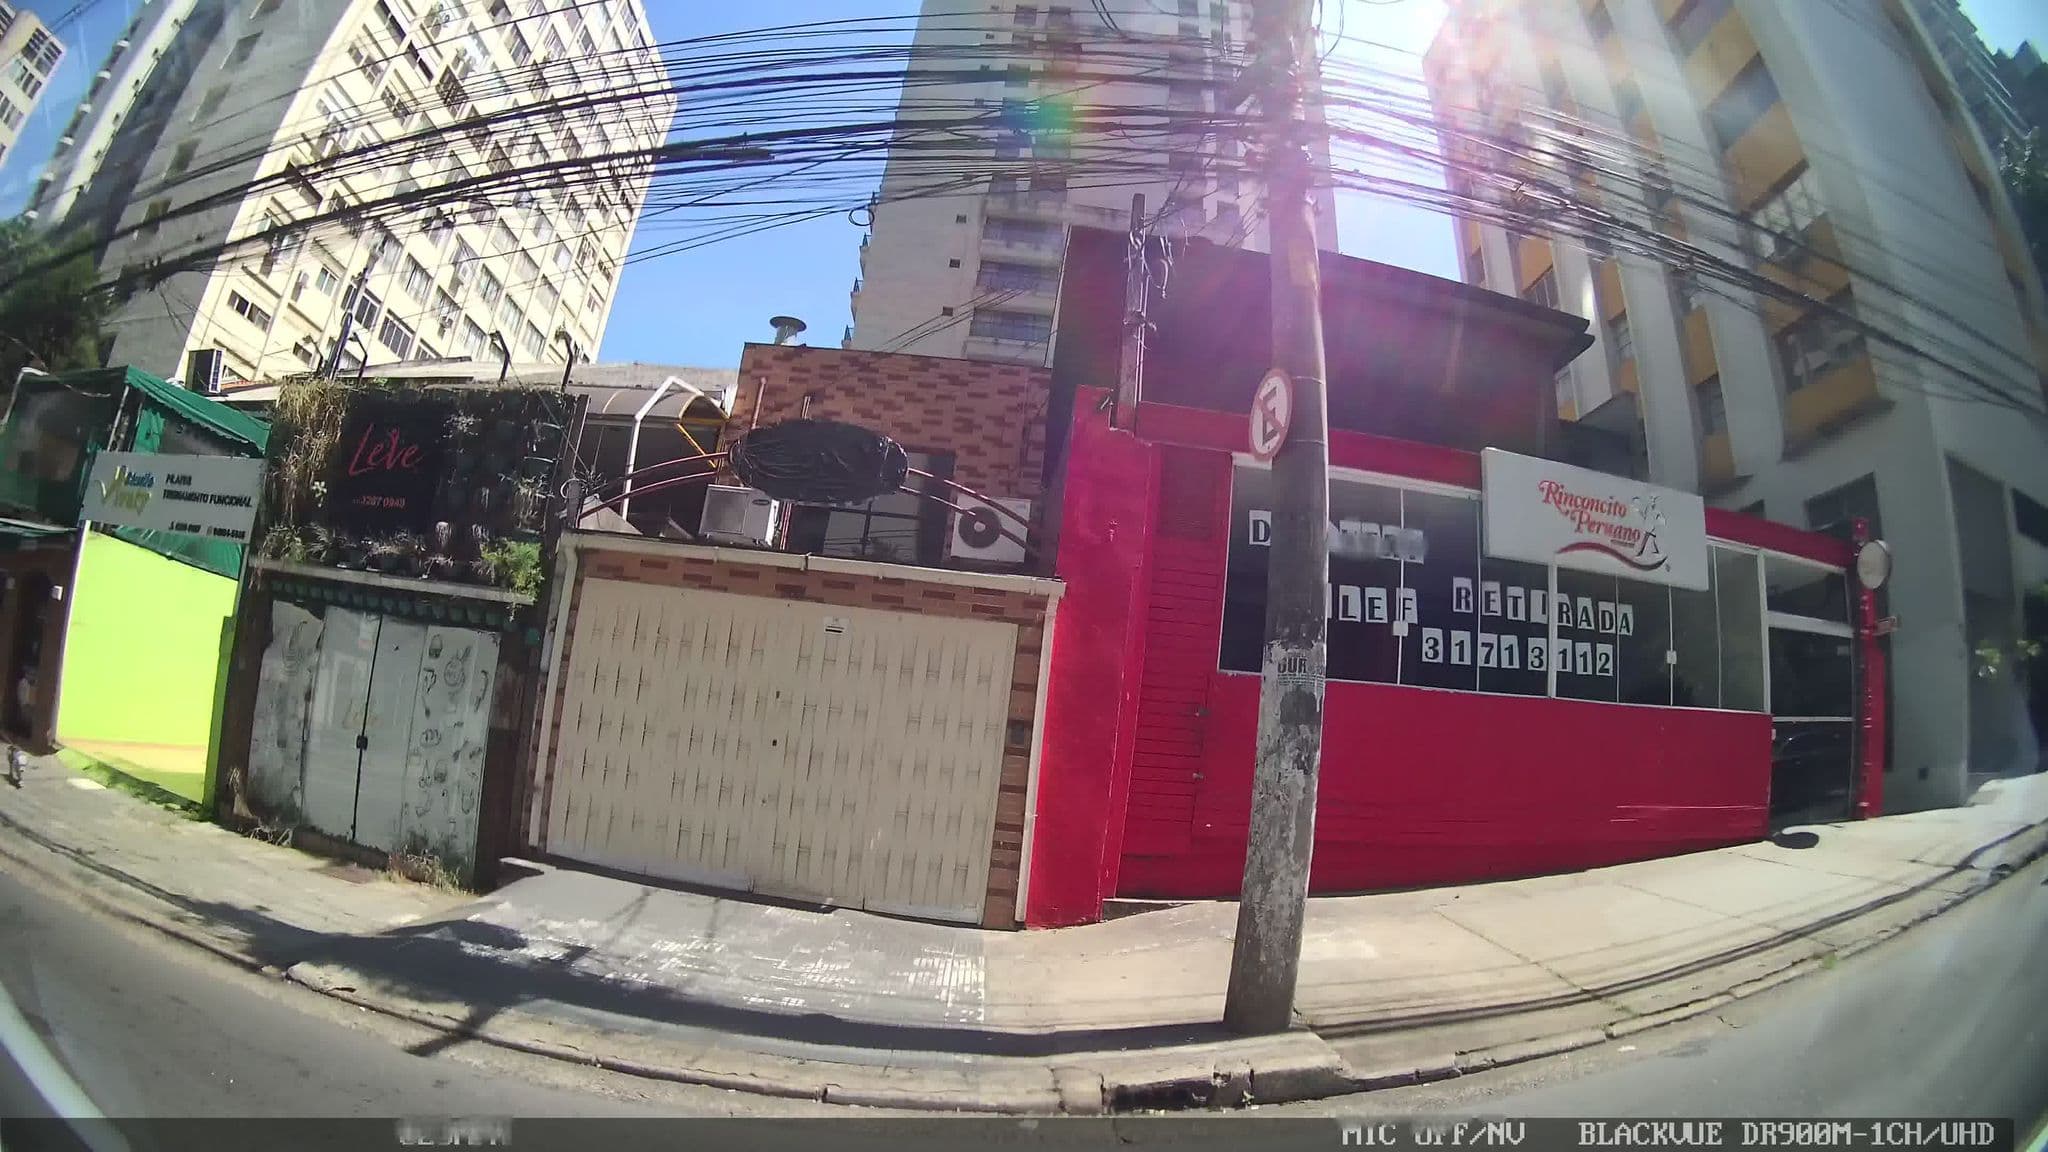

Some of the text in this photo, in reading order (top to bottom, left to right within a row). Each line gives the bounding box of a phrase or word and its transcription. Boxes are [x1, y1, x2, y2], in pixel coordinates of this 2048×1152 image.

[348, 423, 424, 477] Leve
[209, 494, 253, 508] FUNCIONAL
[1538, 480, 1628, 518] Rinconcito
[1570, 508, 1641, 542] Peruano
[1454, 586, 1632, 634] RETIRADA
[1424, 636, 1612, 674] 31713112
